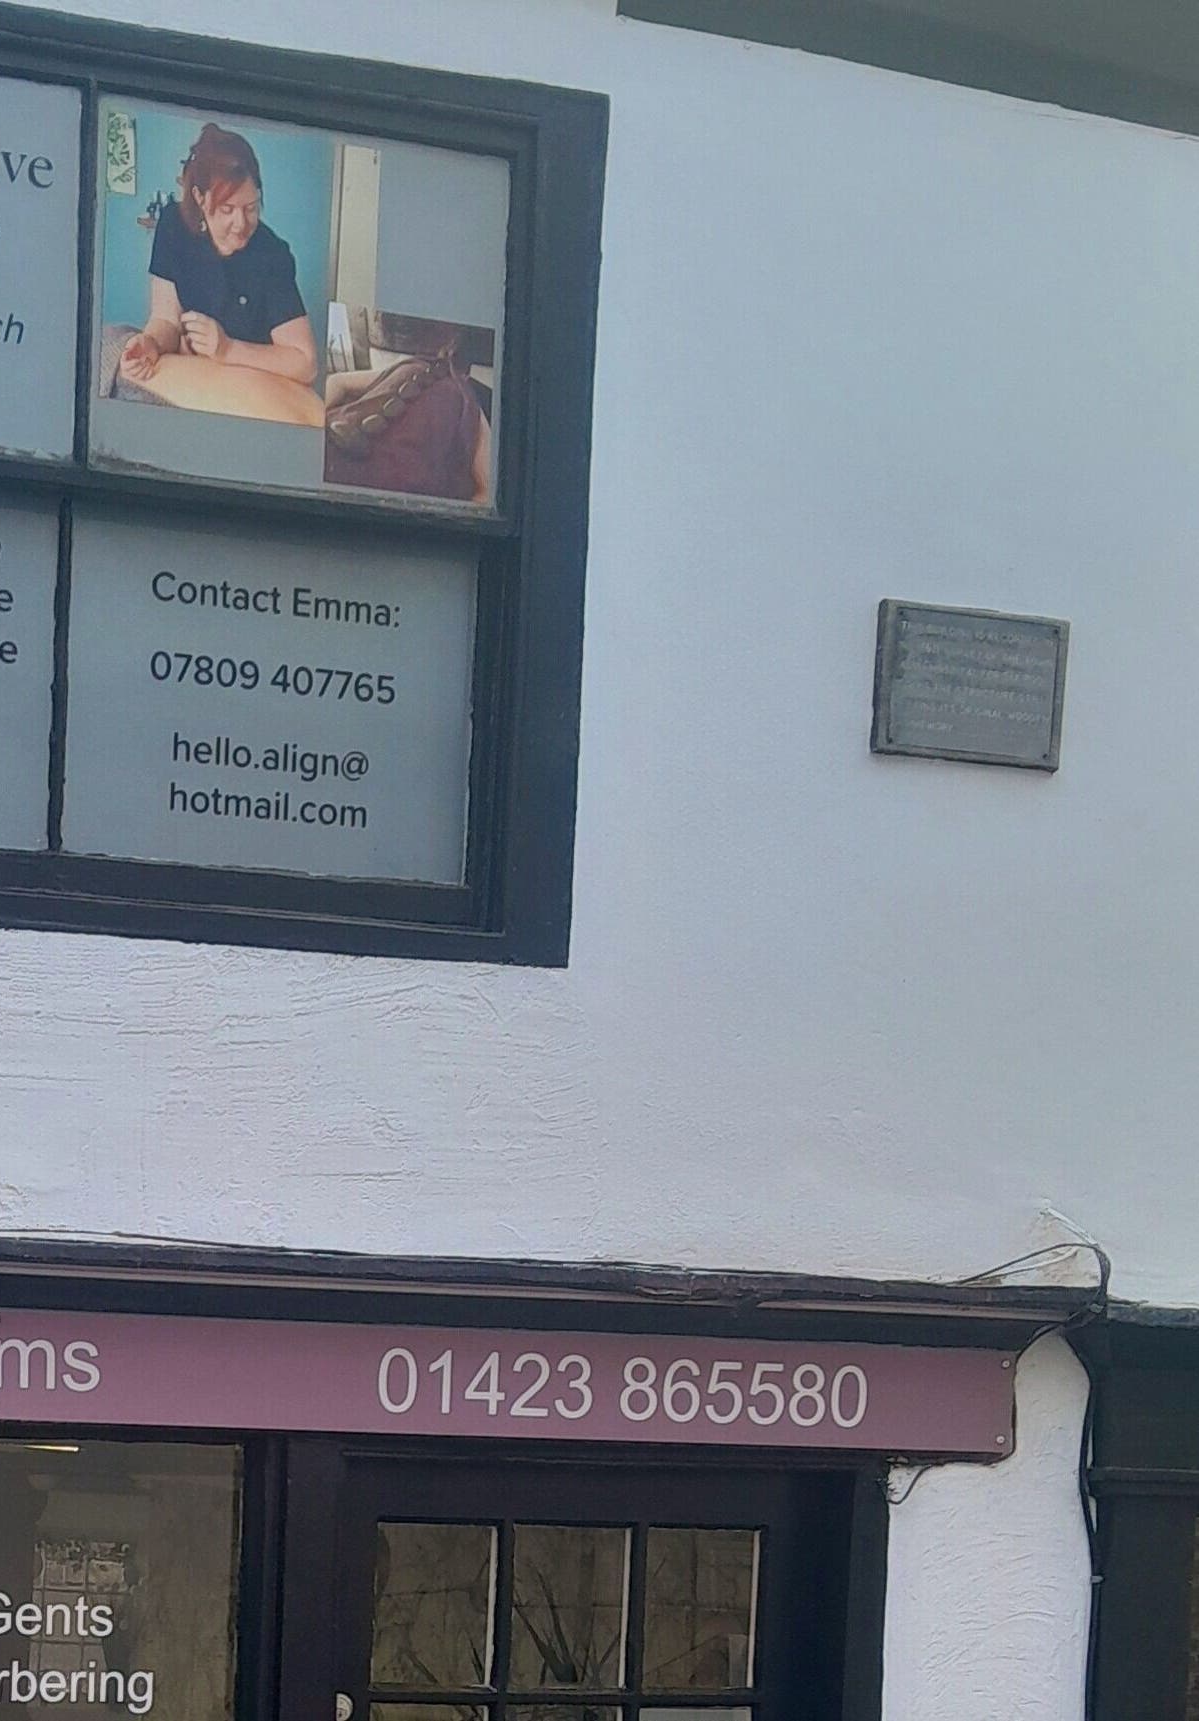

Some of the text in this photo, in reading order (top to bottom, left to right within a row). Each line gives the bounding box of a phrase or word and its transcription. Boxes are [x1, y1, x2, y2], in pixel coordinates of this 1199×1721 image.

[151, 571, 401, 628] Contact Emma:
[150, 650, 396, 704] 07809 407765
[172, 732, 370, 782] hello.align@
[169, 782, 368, 828] hotmail.com
[377, 1347, 868, 1428] 01423 865580
